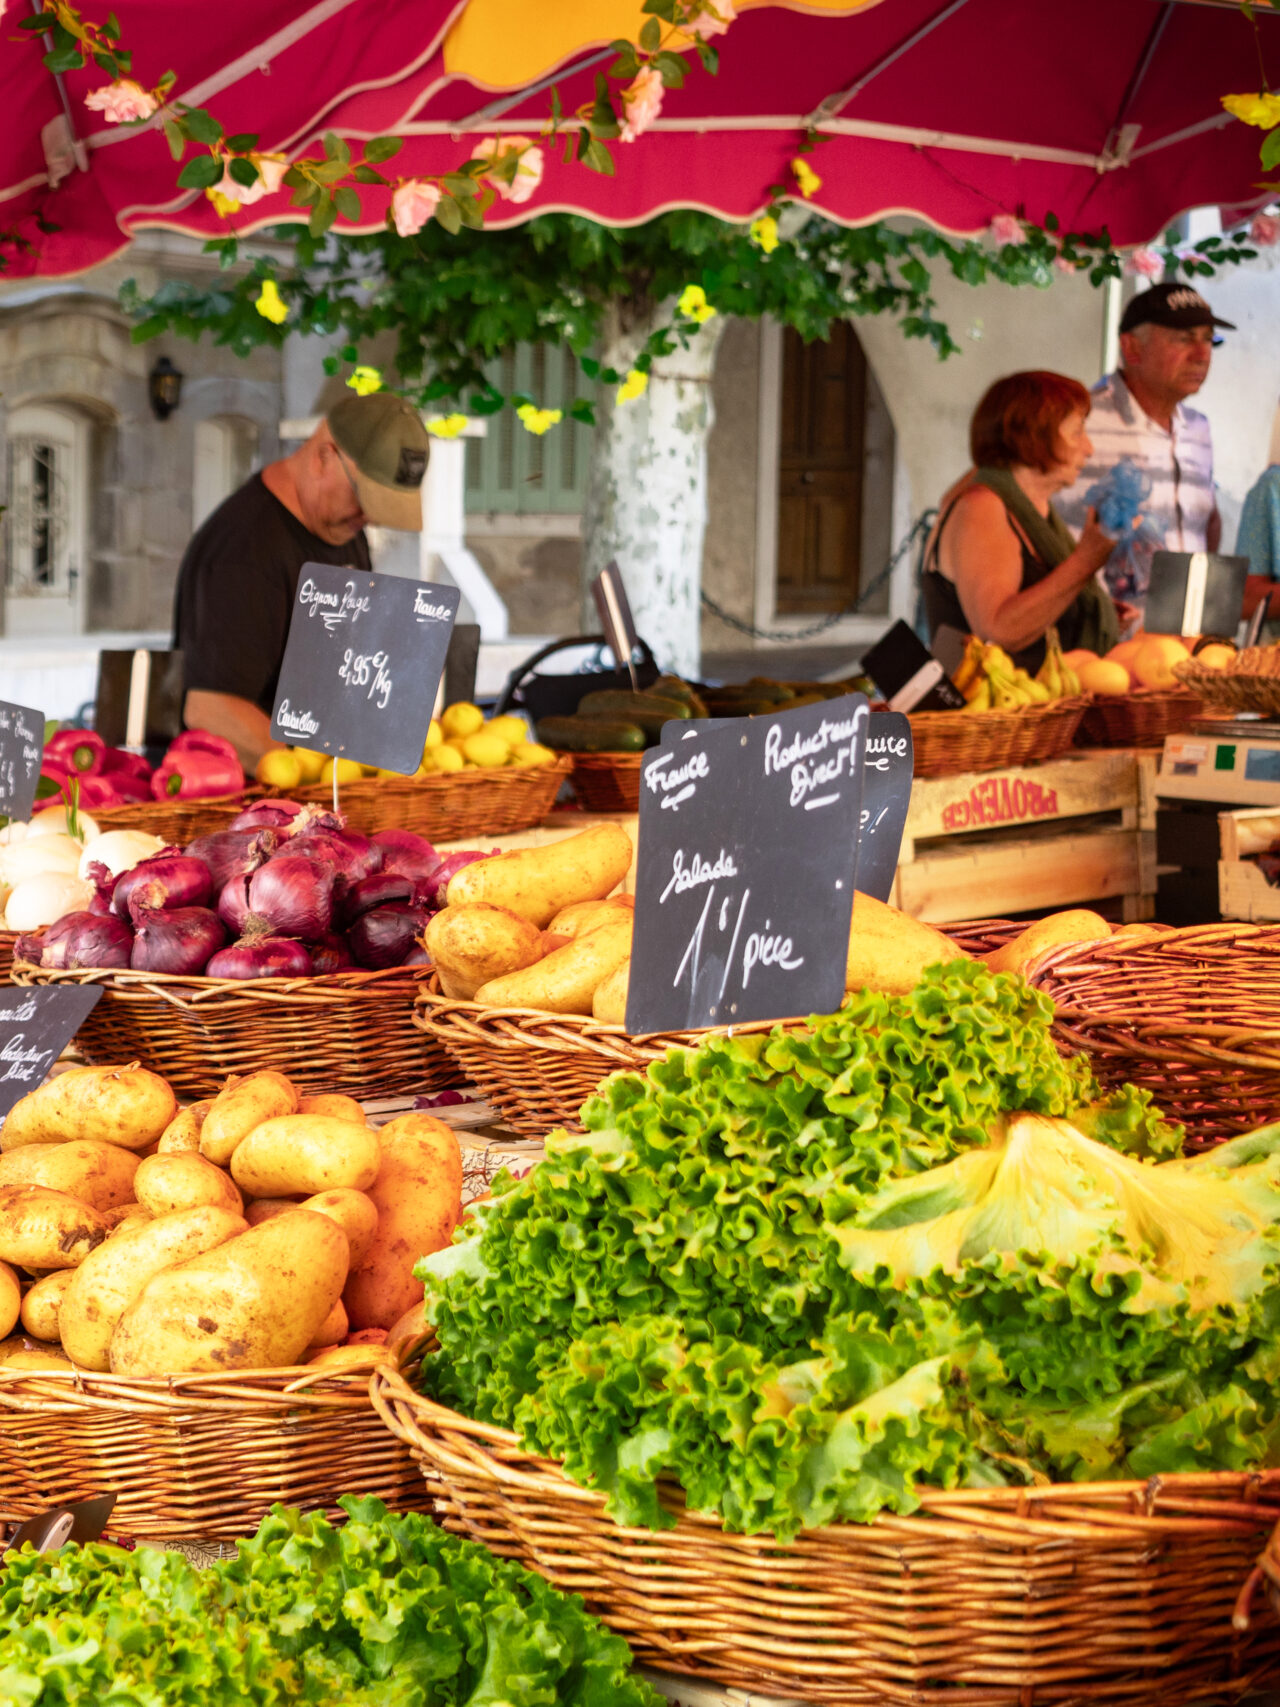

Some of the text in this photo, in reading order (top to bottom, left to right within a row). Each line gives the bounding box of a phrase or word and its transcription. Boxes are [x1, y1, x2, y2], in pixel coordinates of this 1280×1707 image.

[413, 588, 452, 621] France
[764, 704, 869, 776] Producteur
[644, 752, 710, 794] France
[940, 777, 1059, 831] PROVENCE
[659, 849, 738, 904] Salade
